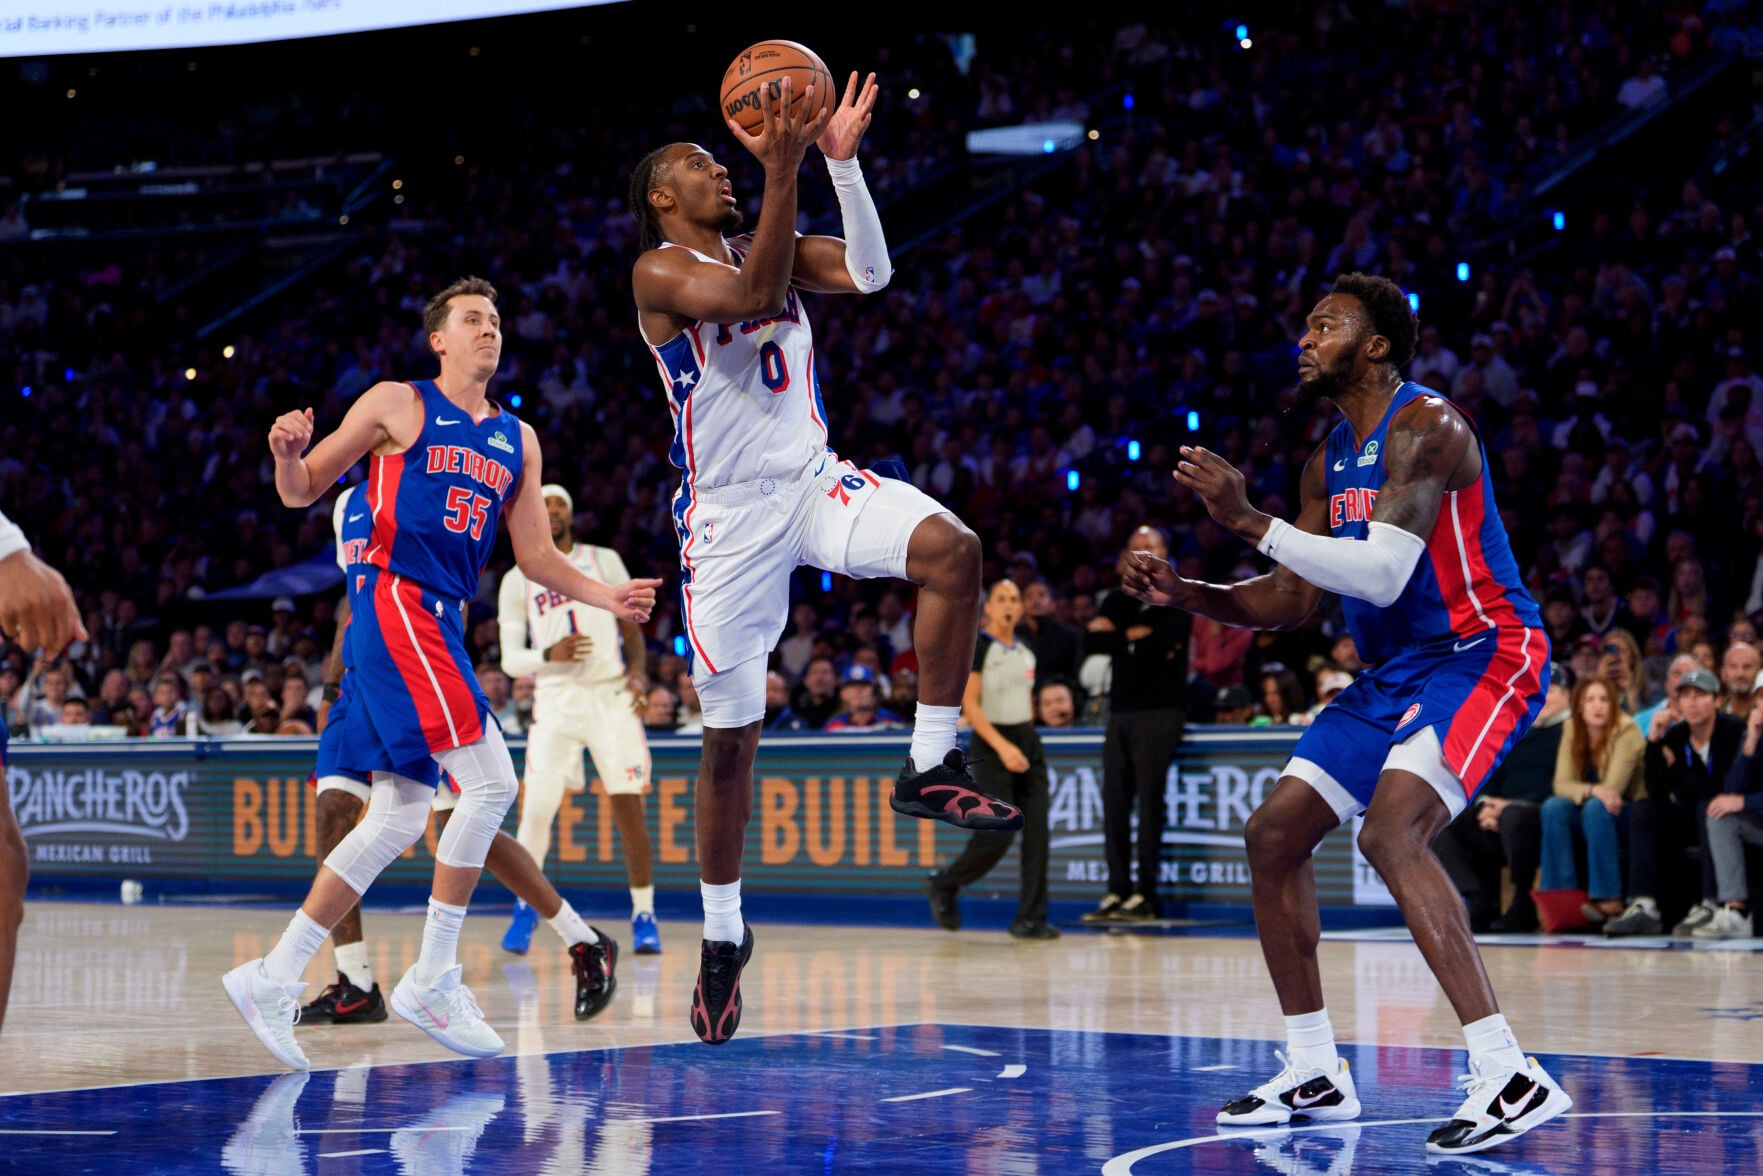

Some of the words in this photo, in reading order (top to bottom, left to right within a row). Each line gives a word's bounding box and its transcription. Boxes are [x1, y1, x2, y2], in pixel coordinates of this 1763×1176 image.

[760, 340, 790, 394] 0
[426, 445, 513, 501] DETROIT
[826, 474, 866, 507] 76
[443, 485, 492, 541] 55
[7, 765, 189, 841] PANCHEROS
[36, 844, 104, 862] MEXICAN
[109, 845, 152, 863] GRILL
